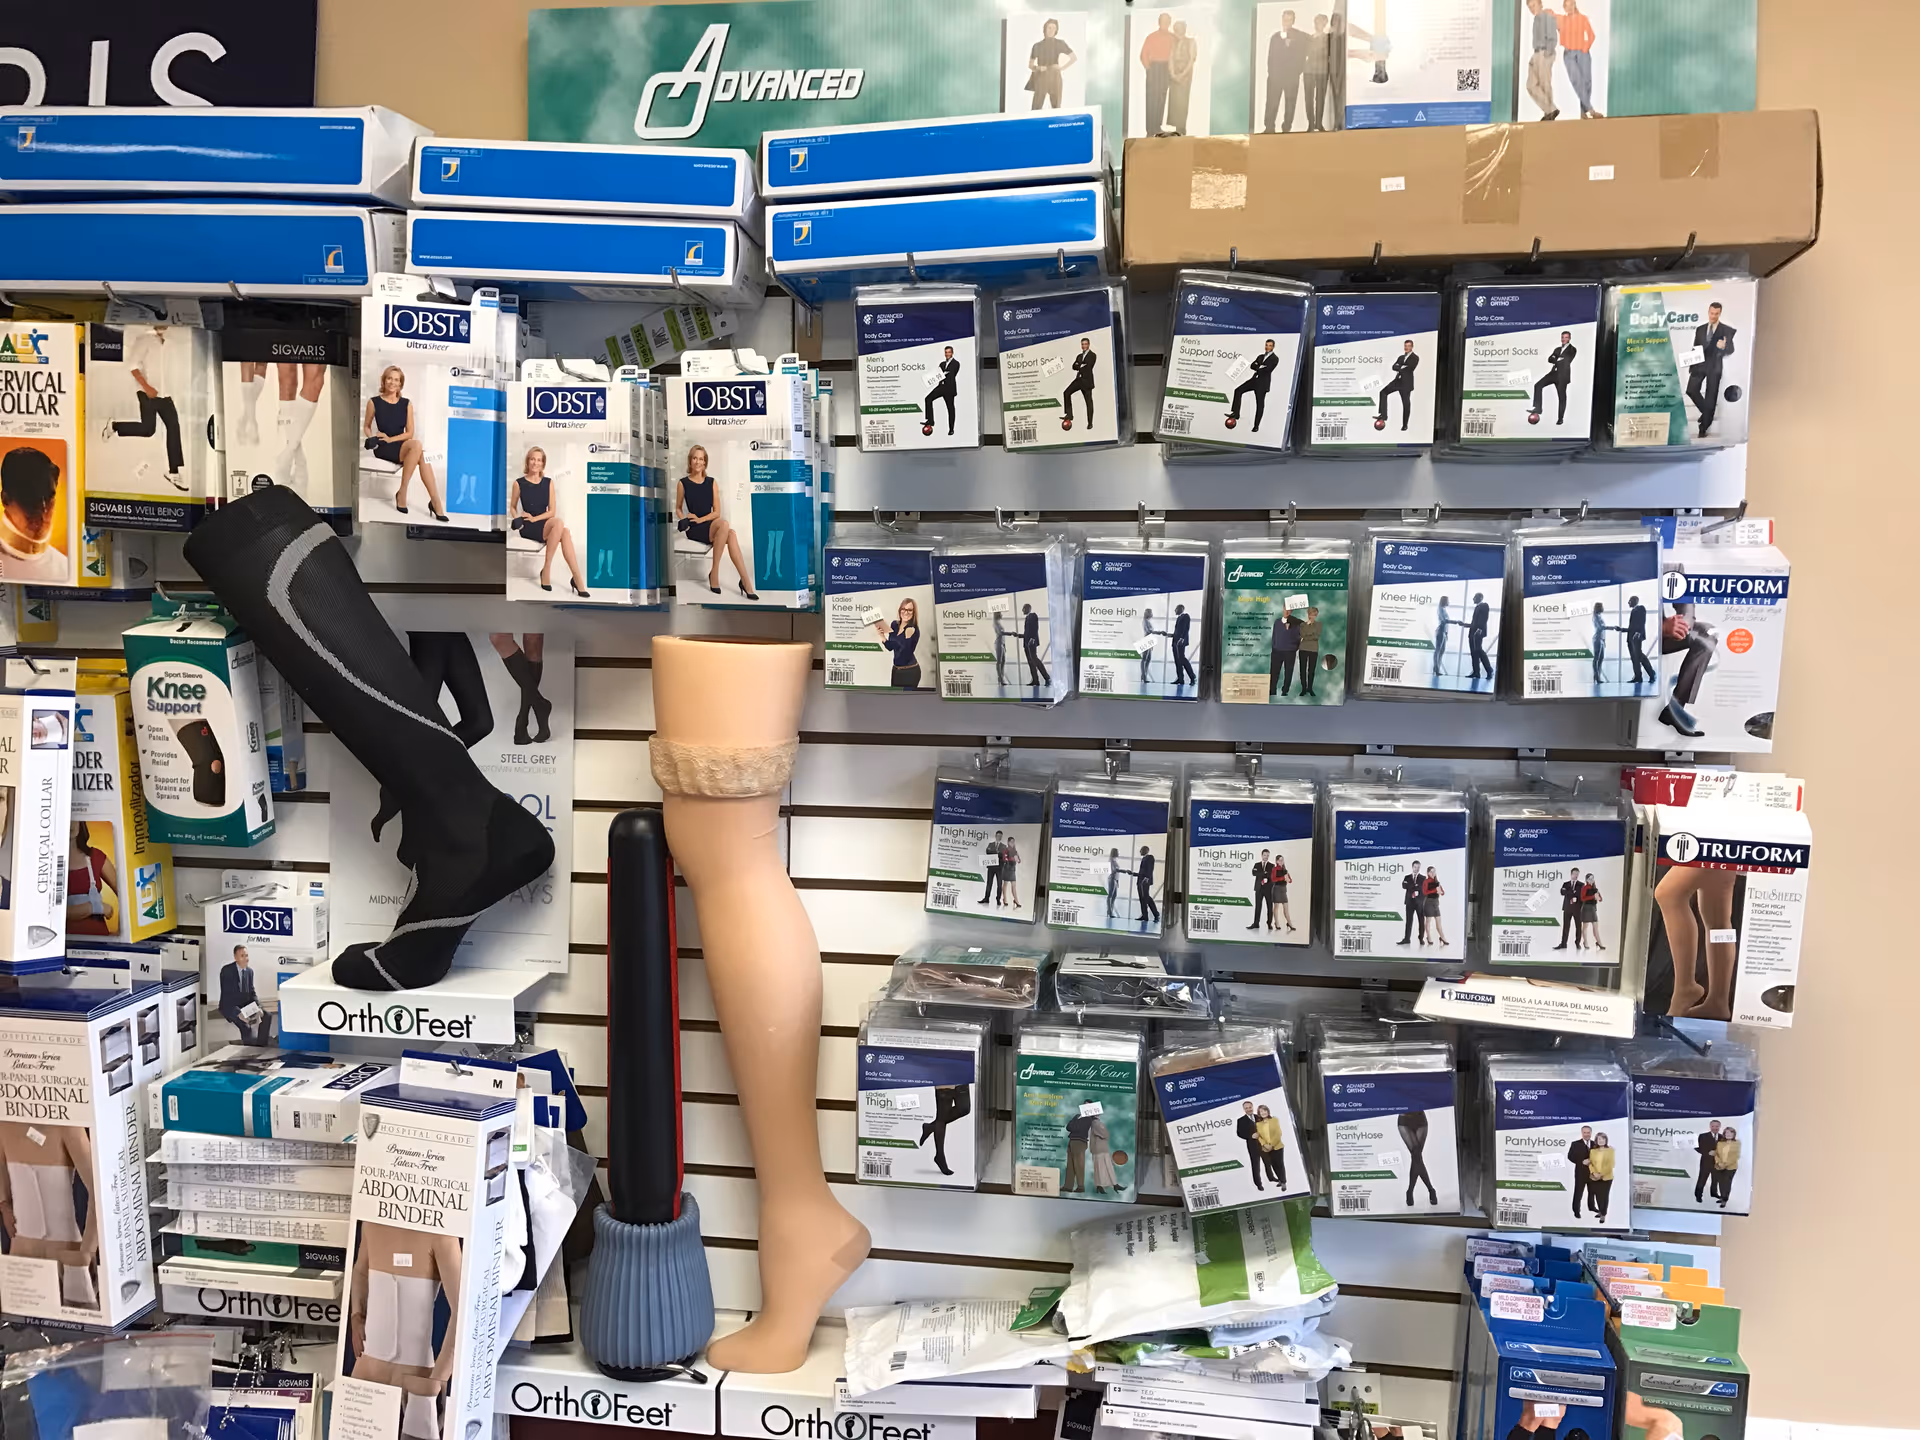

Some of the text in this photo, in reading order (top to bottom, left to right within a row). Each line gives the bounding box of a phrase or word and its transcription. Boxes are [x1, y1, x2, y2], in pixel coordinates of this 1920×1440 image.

[634, 23, 865, 140] ADVANCED
[385, 304, 460, 337] JOBST
[94, 341, 122, 351] SIGVARIS
[1181, 337, 1201, 345] Men's
[271, 343, 326, 357] SIGVARIS
[1179, 346, 1215, 358] Support
[1473, 347, 1538, 357] Support Socks
[1007, 358, 1038, 369] Support
[1321, 355, 1383, 365] Support Socks
[866, 363, 926, 373] Support Socks
[0, 392, 60, 416] OLLAR
[527, 387, 597, 419] JOBST
[687, 382, 755, 414] JOBST
[90, 502, 185, 518] SIGVARIS WELL BEING
[1272, 560, 1308, 580] Body
[1311, 560, 1342, 577] Care
[1688, 578, 1783, 594] TRUFORM
[1380, 591, 1432, 604] Knee High
[1724, 597, 1772, 605] HEALTH
[832, 604, 853, 612] Knee
[1090, 606, 1138, 618] Knee High
[1532, 604, 1559, 613] Knee
[943, 609, 987, 620] Knee High
[164, 671, 182, 679] Sport
[147, 676, 207, 700] Knee
[146, 699, 202, 715] Support
[147, 725, 164, 734] Open
[150, 750, 178, 759] Provides
[500, 753, 557, 765] STEEL GREY
[151, 759, 170, 767] Relief
[154, 775, 190, 785] Support for
[154, 784, 177, 792] Strains
[156, 792, 180, 801] Sprains
[38, 777, 53, 894] CERVICAL COLLAR
[939, 826, 989, 841] Thigh High
[1058, 844, 1104, 856] Knee High
[1198, 848, 1254, 861] Thigh High
[1700, 842, 1802, 863] TRUFORM
[1213, 861, 1242, 869] Uni-Band
[1344, 861, 1404, 875] Thigh High
[1701, 862, 1793, 875] LEG HEALTH
[1503, 869, 1563, 881] Thigh High
[224, 905, 284, 932] JOBST
[1456, 992, 1493, 1003] TRUFORM
[1501, 995, 1527, 1004] MEDIAS
[1534, 998, 1544, 1006] LA
[1544, 999, 1569, 1009] ALTURA
[1570, 1002, 1582, 1010] DEL
[1583, 1003, 1609, 1013] MUSLO
[1739, 1014, 1773, 1023] ONE PAIR
[41, 1075, 89, 1087] SURGICAL
[493, 1079, 503, 1089] M
[0, 1083, 89, 1104] BDOMINAL
[865, 1097, 893, 1109] Thigh
[5, 1101, 70, 1120] BINDER
[1176, 1117, 1233, 1135] PantyHose
[380, 1124, 472, 1145] HOSPITAL GRADE
[1336, 1131, 1384, 1141] PantyHose
[1505, 1135, 1566, 1148] PantyHose
[386, 1143, 445, 1162] Premium Series
[360, 1165, 471, 1192] FOUR-PANEL SURGICAL
[359, 1179, 468, 1211] ABDOMINAL
[131, 1166, 147, 1262] ABDOMINAL
[378, 1201, 444, 1228] BINDER
[305, 1251, 340, 1263] SIGVARIS
[482, 1289, 500, 1400] ABDOMINAL
[278, 1379, 310, 1387] SIGVARIS
[1066, 1421, 1092, 1433] SIGVARIS
